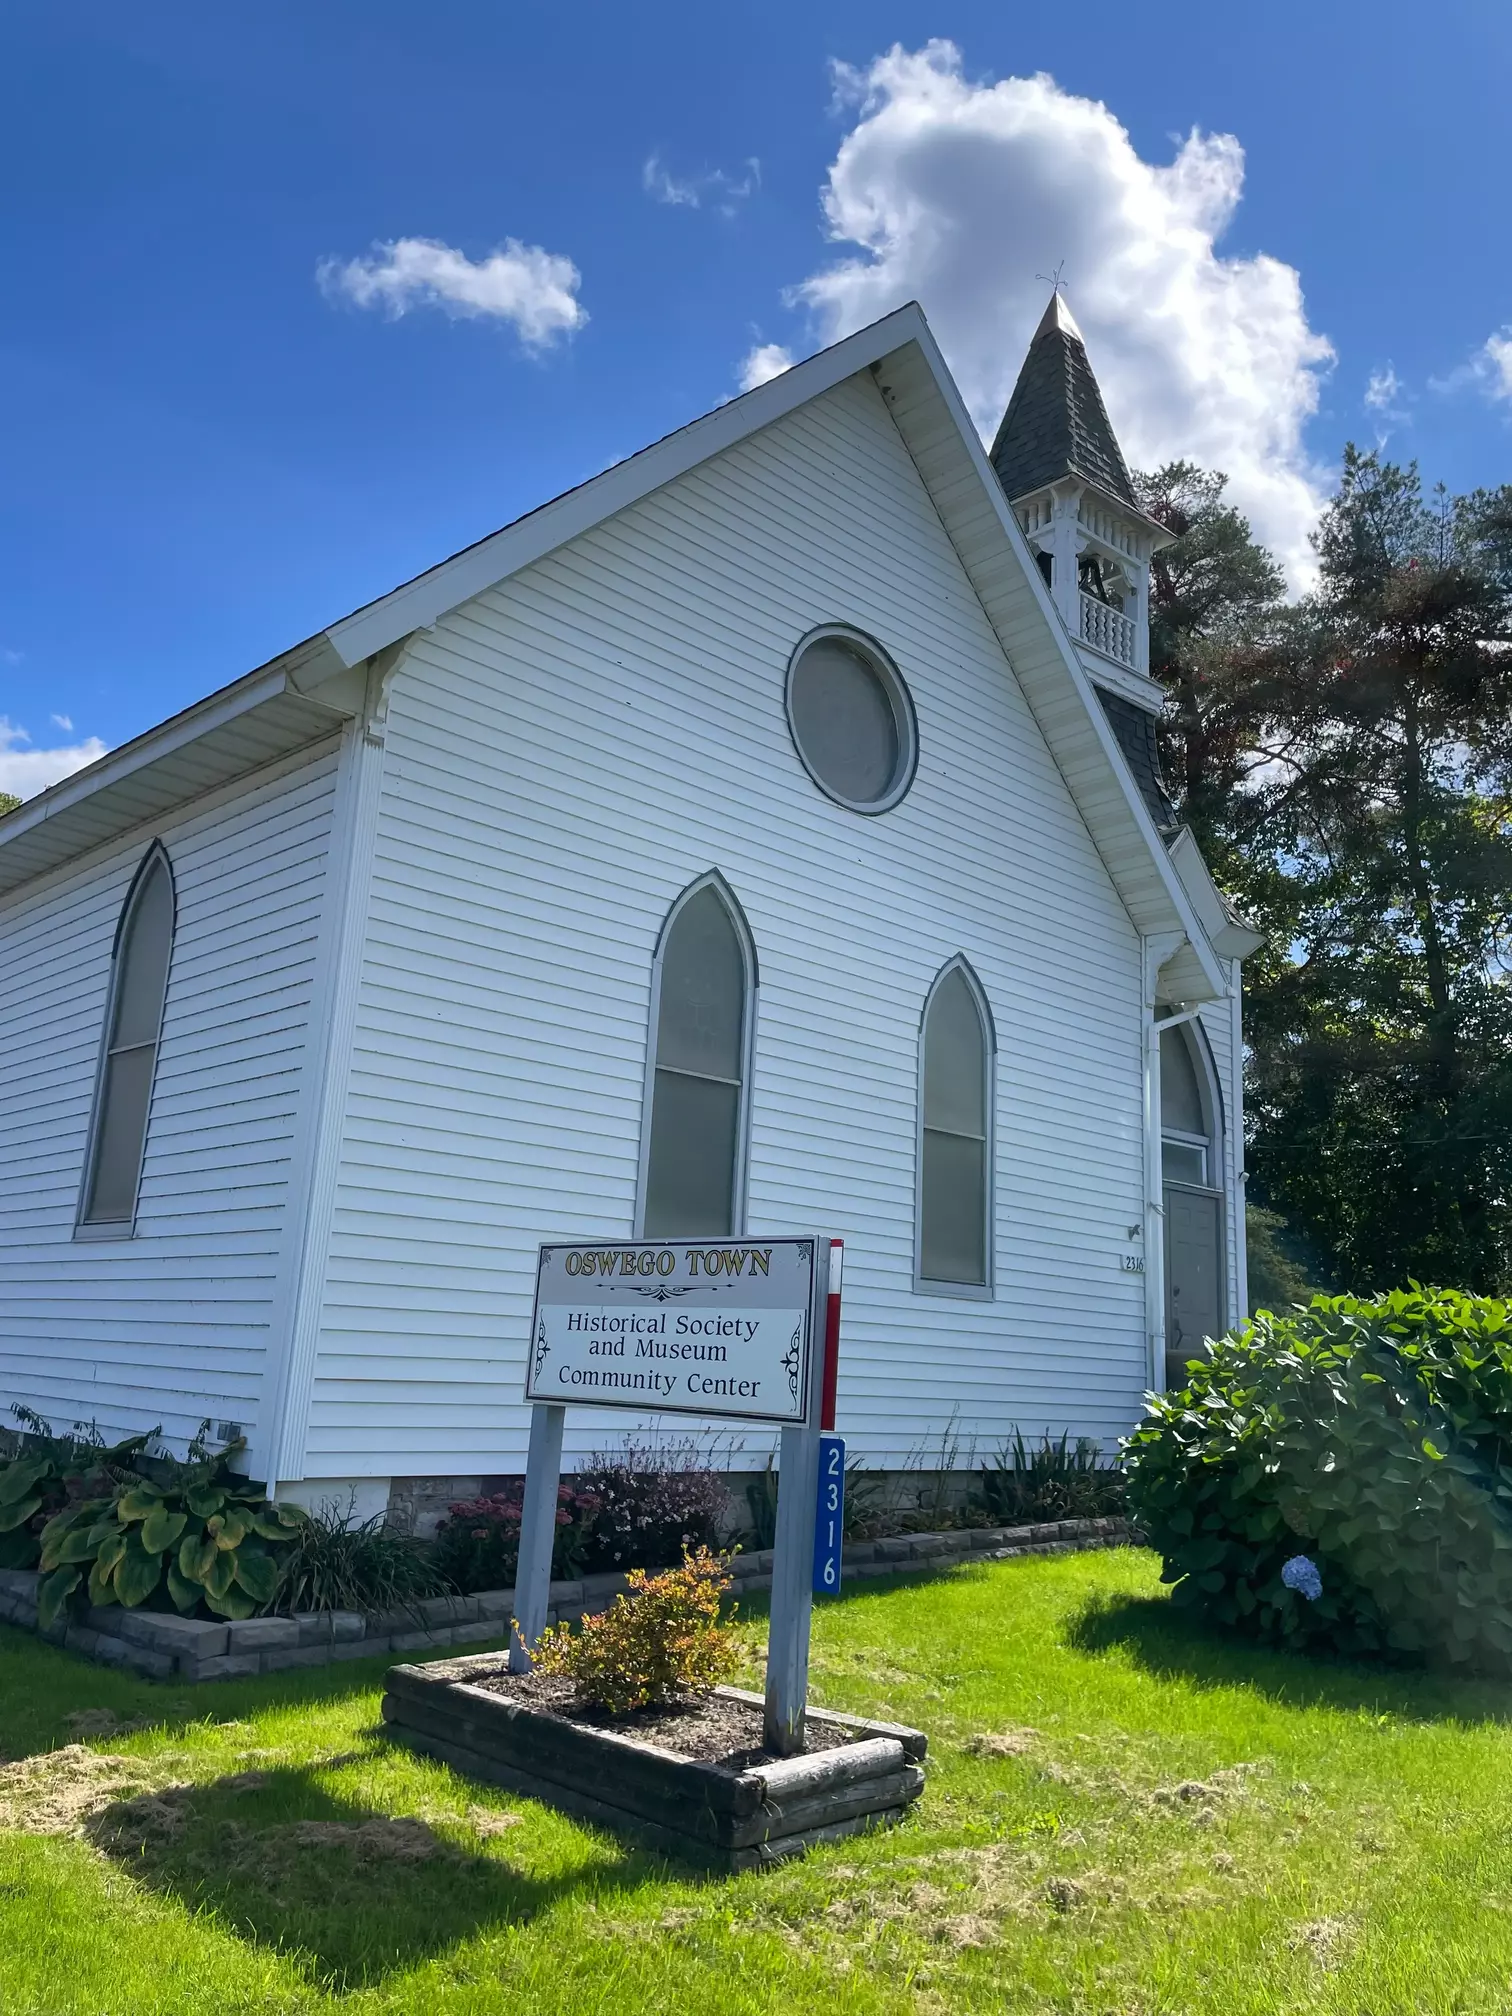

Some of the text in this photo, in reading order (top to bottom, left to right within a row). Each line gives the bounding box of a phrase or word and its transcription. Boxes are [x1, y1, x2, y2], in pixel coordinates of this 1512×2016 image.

[565, 1248, 772, 1277] OSWEGO TOWN
[1126, 1256, 1144, 1272] 2316
[567, 1312, 760, 1343] Historical Society
[588, 1336, 727, 1362] and Museum
[558, 1365, 761, 1398] Community Center
[823, 1447, 840, 1585] 2316
